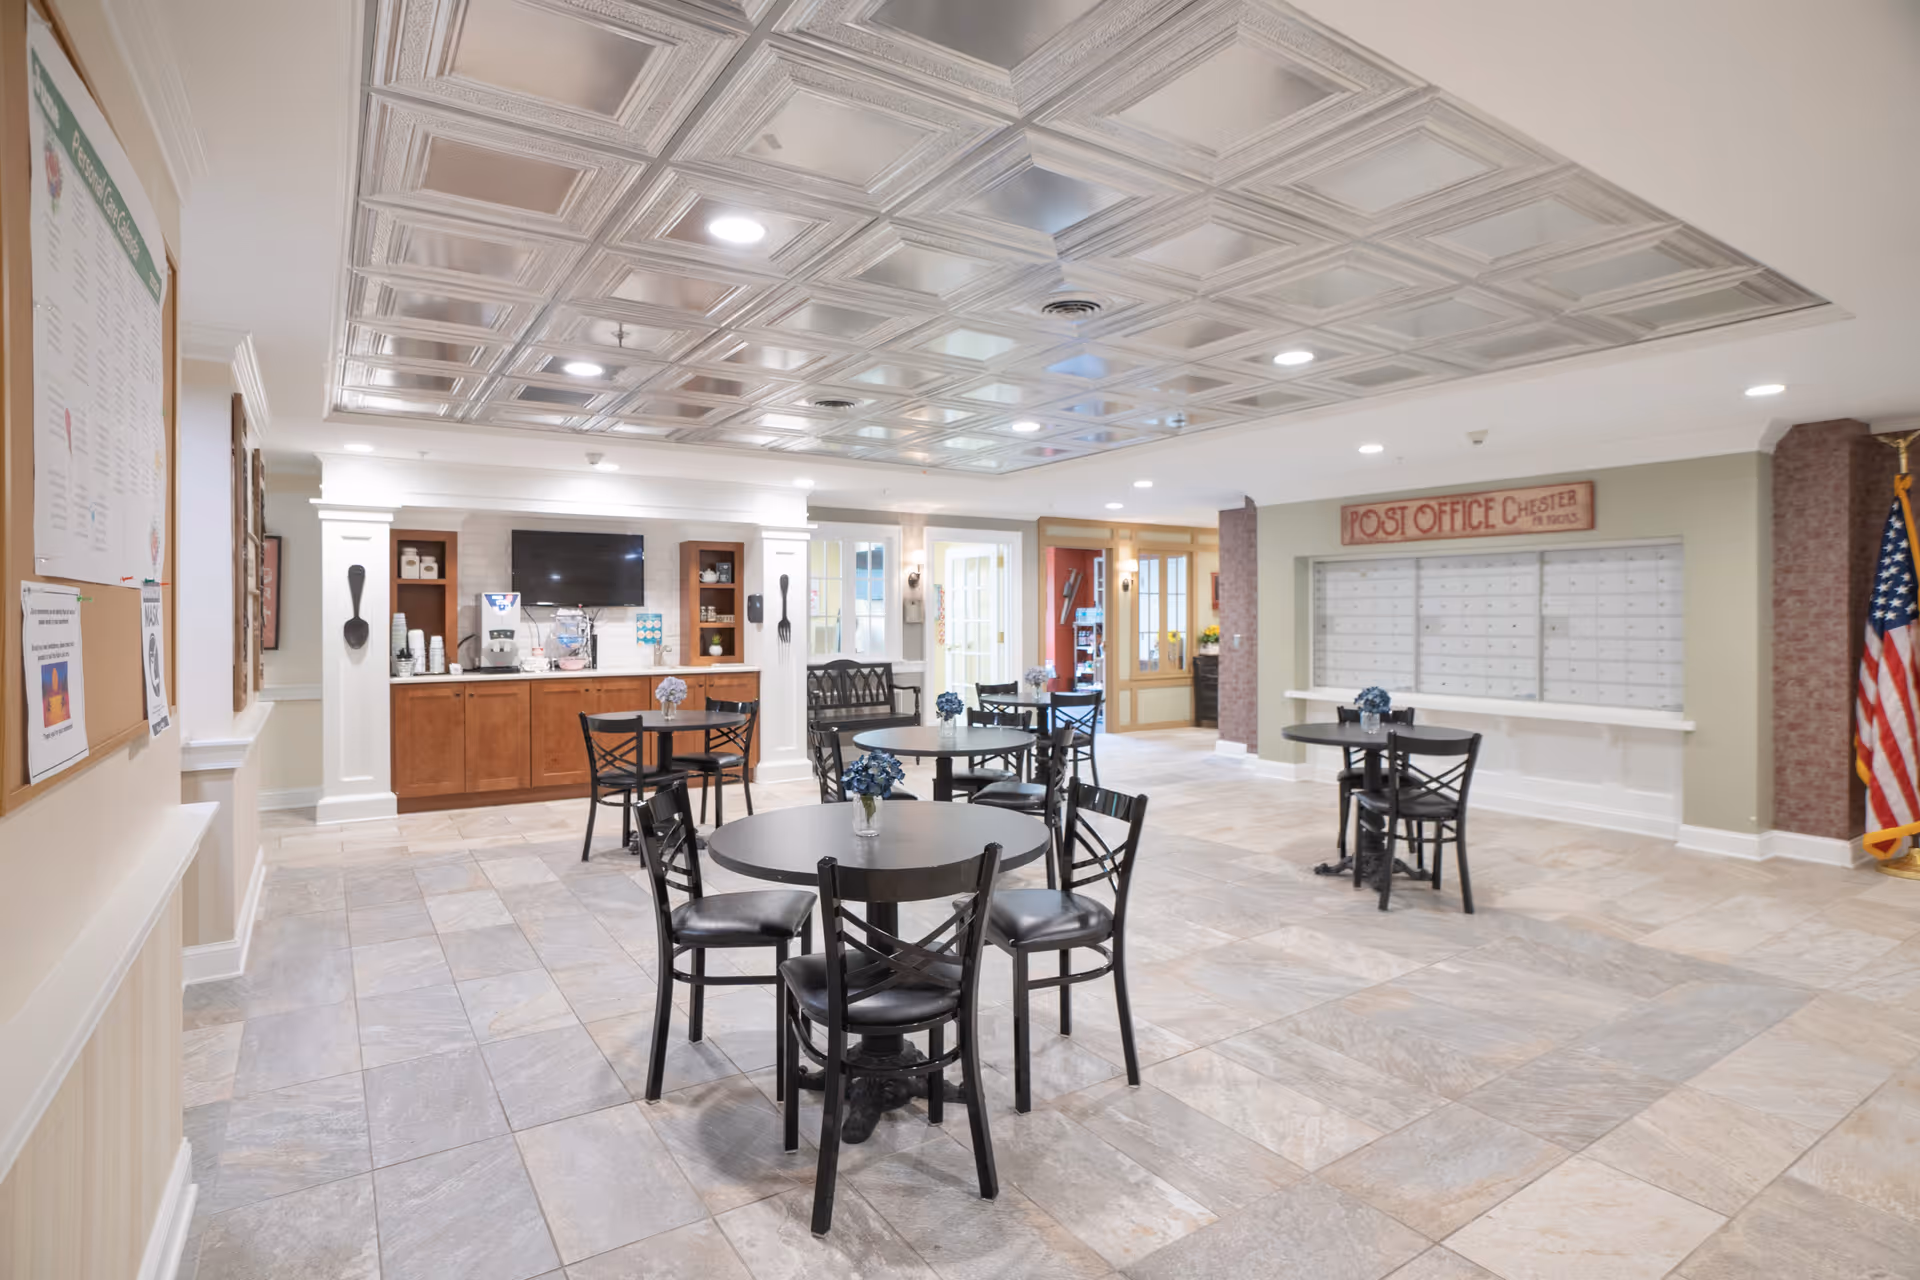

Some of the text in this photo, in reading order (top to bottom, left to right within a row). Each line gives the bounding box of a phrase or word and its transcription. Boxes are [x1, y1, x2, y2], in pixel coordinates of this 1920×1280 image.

[72, 129, 140, 262] Personal Care Calendar
[1350, 489, 1577, 538] POST OFFICE CHESTER
[144, 604, 159, 627] MASK
